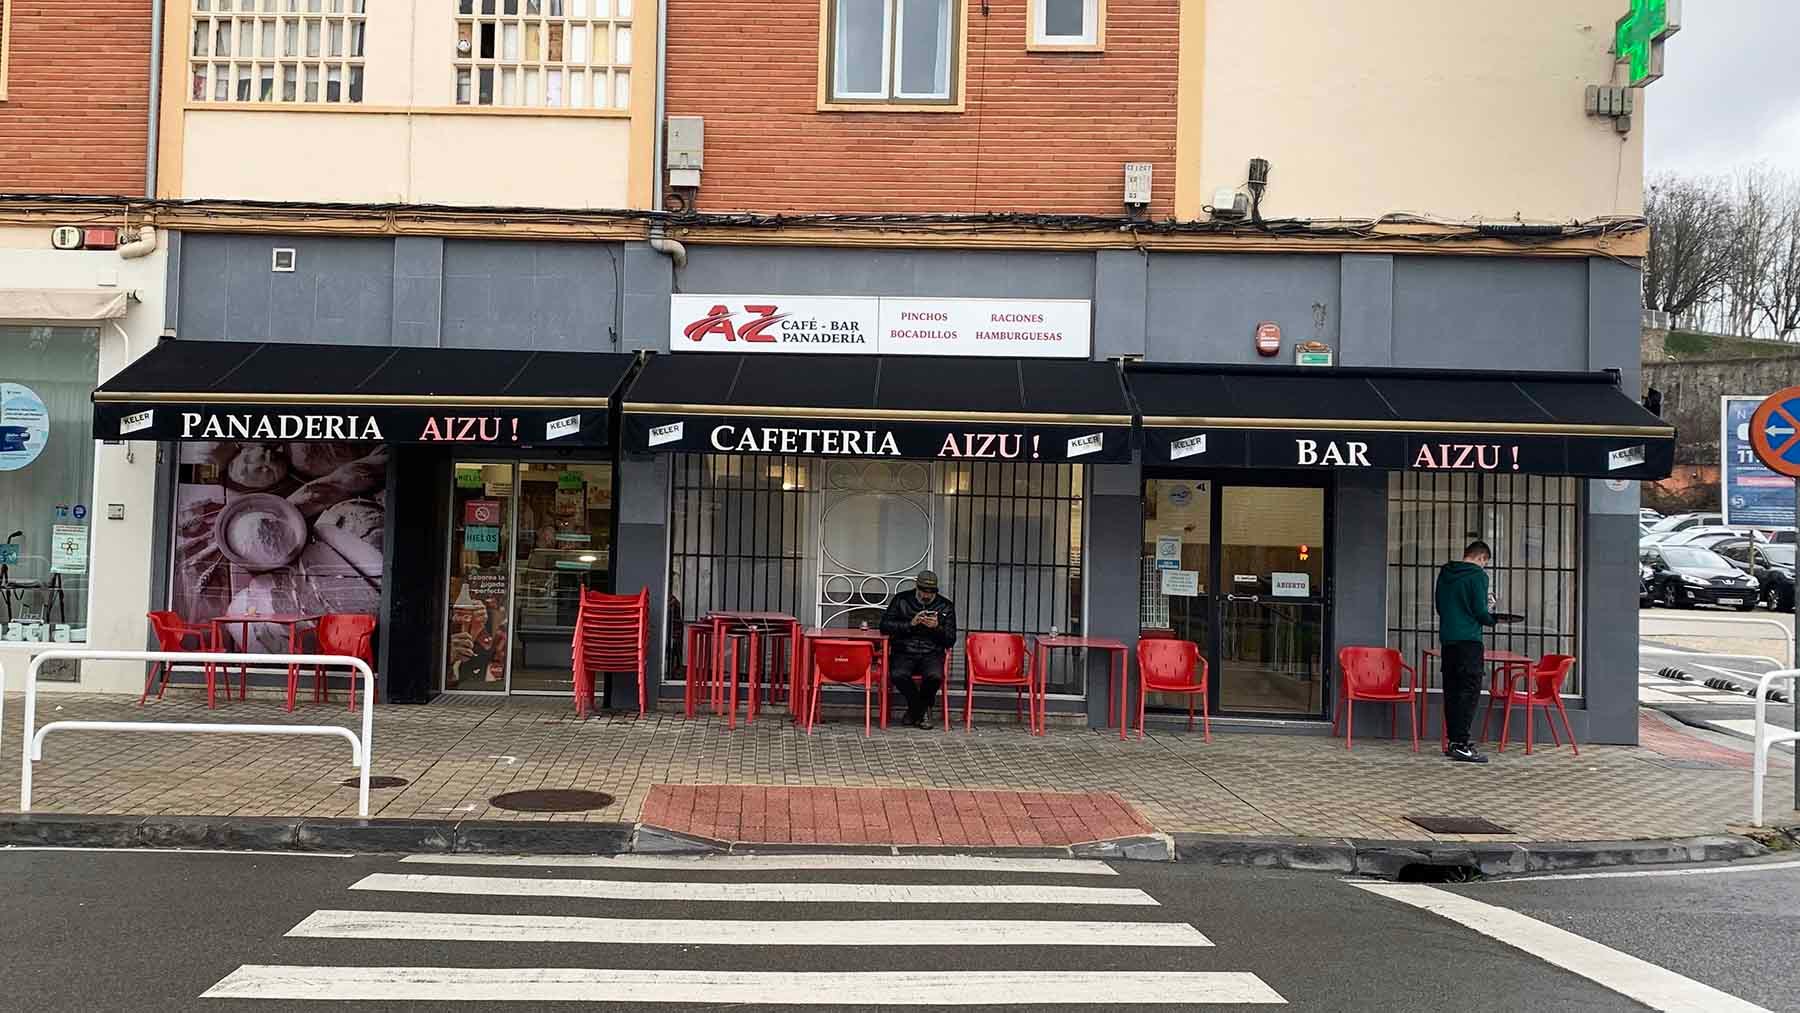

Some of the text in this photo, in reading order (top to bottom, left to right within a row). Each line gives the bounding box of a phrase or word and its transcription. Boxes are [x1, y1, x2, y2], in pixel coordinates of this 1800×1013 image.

[901, 311, 948, 322] PINCHOS
[991, 313, 1044, 323] RACIONES
[684, 305, 792, 343] AZ
[781, 316, 818, 331] CAFÉ
[830, 320, 860, 331] BAR
[782, 330, 865, 344] PANADERÍA
[890, 329, 958, 340] BOCADILLOS
[975, 331, 1063, 341] HAMBURGUESAS
[123, 412, 150, 425] KELER
[550, 417, 578, 430] KELER
[181, 412, 385, 440] PANADERIA
[419, 416, 502, 441] AIZU
[652, 424, 680, 437] KELER
[710, 425, 902, 455] CAFETERIA
[937, 432, 1023, 458] AIZU
[1071, 435, 1099, 447] KELER
[1174, 437, 1202, 449] KELER
[1296, 440, 1372, 467] BAR
[1412, 444, 1501, 470] AIZU
[467, 532, 497, 543] HIELOS
[1276, 581, 1306, 589] ABIERTO
